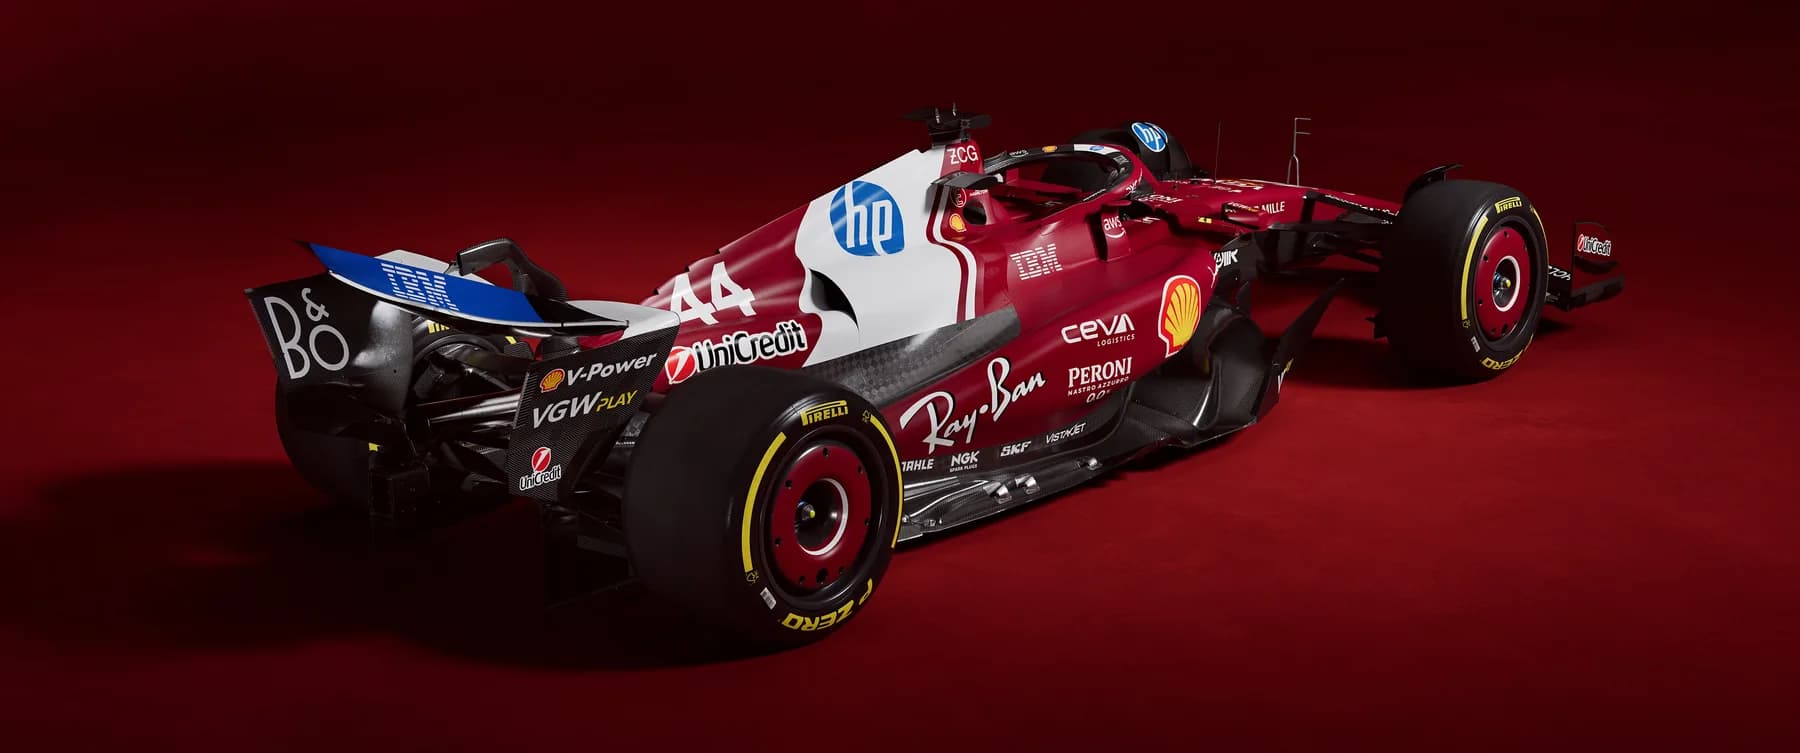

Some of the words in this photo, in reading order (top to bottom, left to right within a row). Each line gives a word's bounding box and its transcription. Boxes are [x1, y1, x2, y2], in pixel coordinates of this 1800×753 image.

[946, 145, 979, 165] ZCG
[844, 181, 893, 255] hp
[1262, 201, 1285, 214] MILLE
[1494, 196, 1523, 214] PIRELLI
[1103, 215, 1123, 231] aws
[1009, 243, 1063, 280] IBM
[381, 262, 460, 311] IBM
[671, 261, 757, 326] 44
[692, 319, 808, 373] UniCredit
[1096, 334, 1135, 347] LOGISTICS
[567, 353, 657, 386] V-Power
[1068, 356, 1132, 388] PERONI
[1067, 384, 1097, 396] NASTRO
[532, 391, 602, 429] VGW
[596, 389, 639, 412] PLAY
[800, 400, 849, 426] PIRELLI
[950, 450, 980, 467] NGK
[1000, 440, 1032, 457] SKF
[519, 465, 562, 491] UniCredit
[781, 600, 855, 631] ZERO
